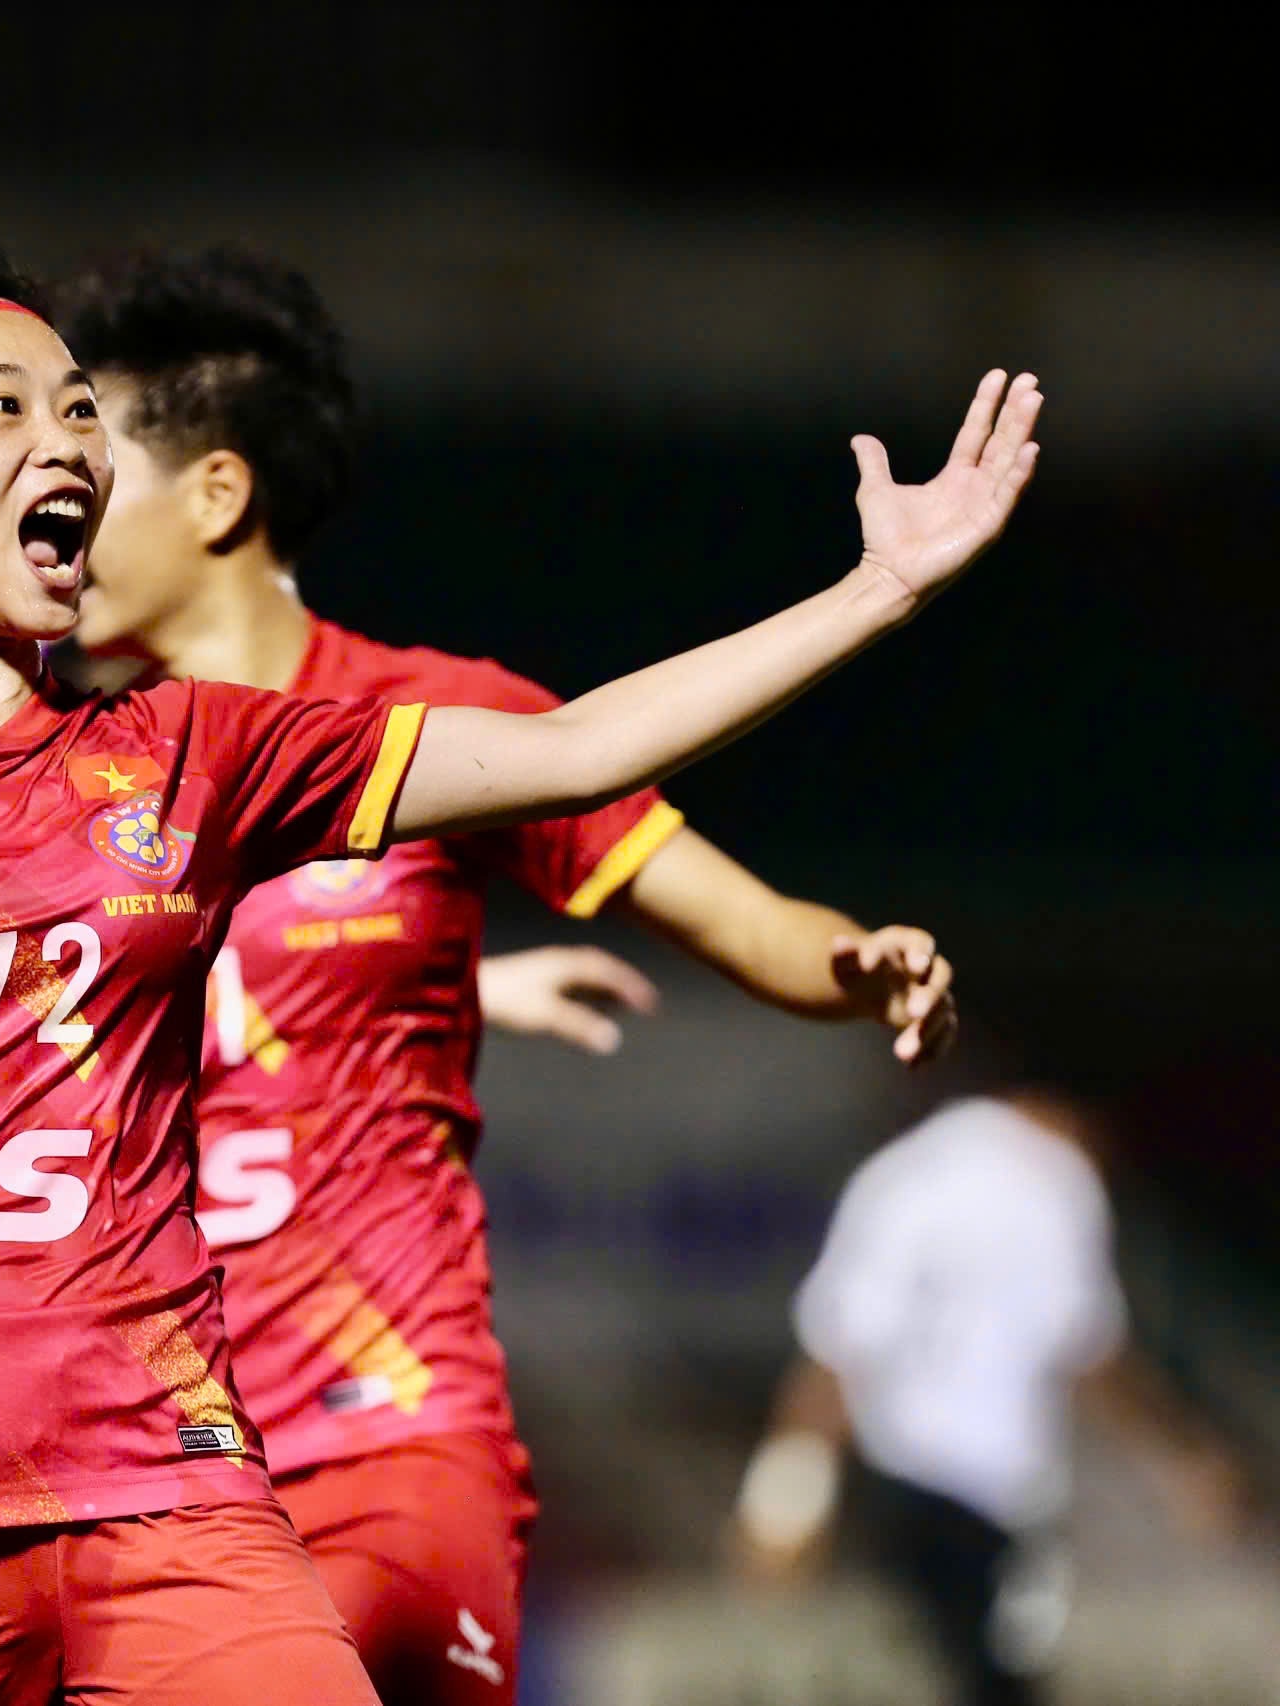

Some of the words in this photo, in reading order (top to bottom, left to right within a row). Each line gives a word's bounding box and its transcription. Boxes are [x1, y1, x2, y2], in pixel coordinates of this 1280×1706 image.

[102, 894, 157, 918] VIET
[161, 893, 198, 914] NAM
[194, 1127, 297, 1247] S
